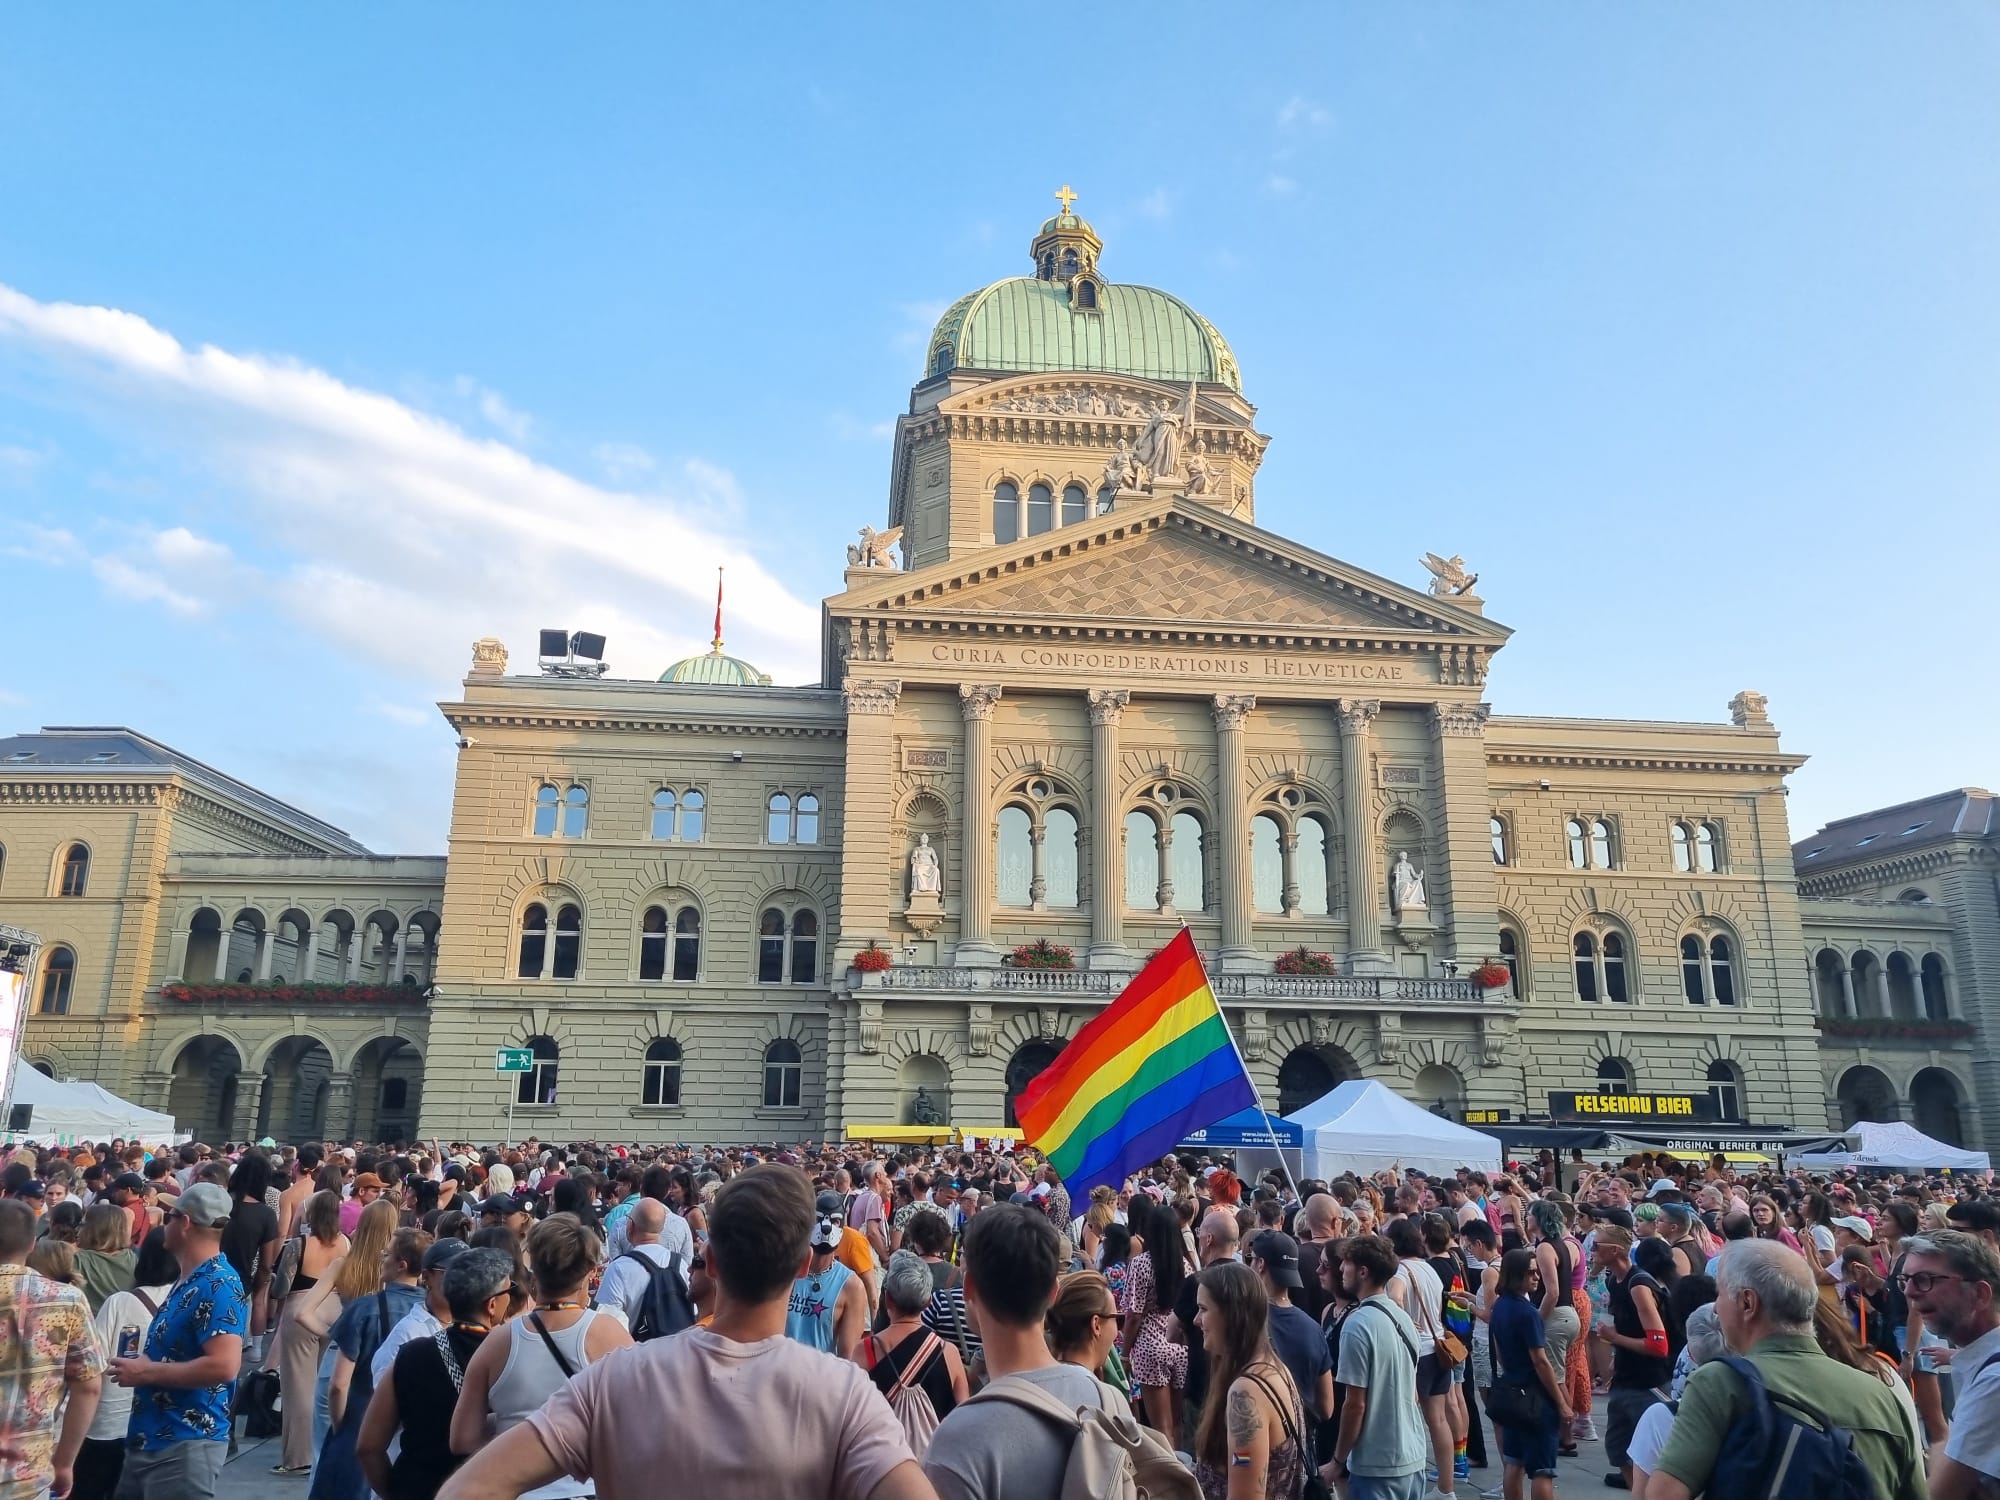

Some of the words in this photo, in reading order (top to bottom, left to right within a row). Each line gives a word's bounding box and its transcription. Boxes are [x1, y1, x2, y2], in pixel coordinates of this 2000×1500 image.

[931, 645, 1007, 664] CURIA
[1021, 648, 1249, 675] CONFOEDERATIONIS
[1264, 657, 1402, 680] HELVETICAE
[1574, 1095, 1652, 1114] FELSENAU
[1656, 1097, 1692, 1115] BIER
[1666, 1140, 1714, 1150] ORIGINAL
[1719, 1141, 1757, 1151] BERNER
[1762, 1142, 1784, 1152] BIER
